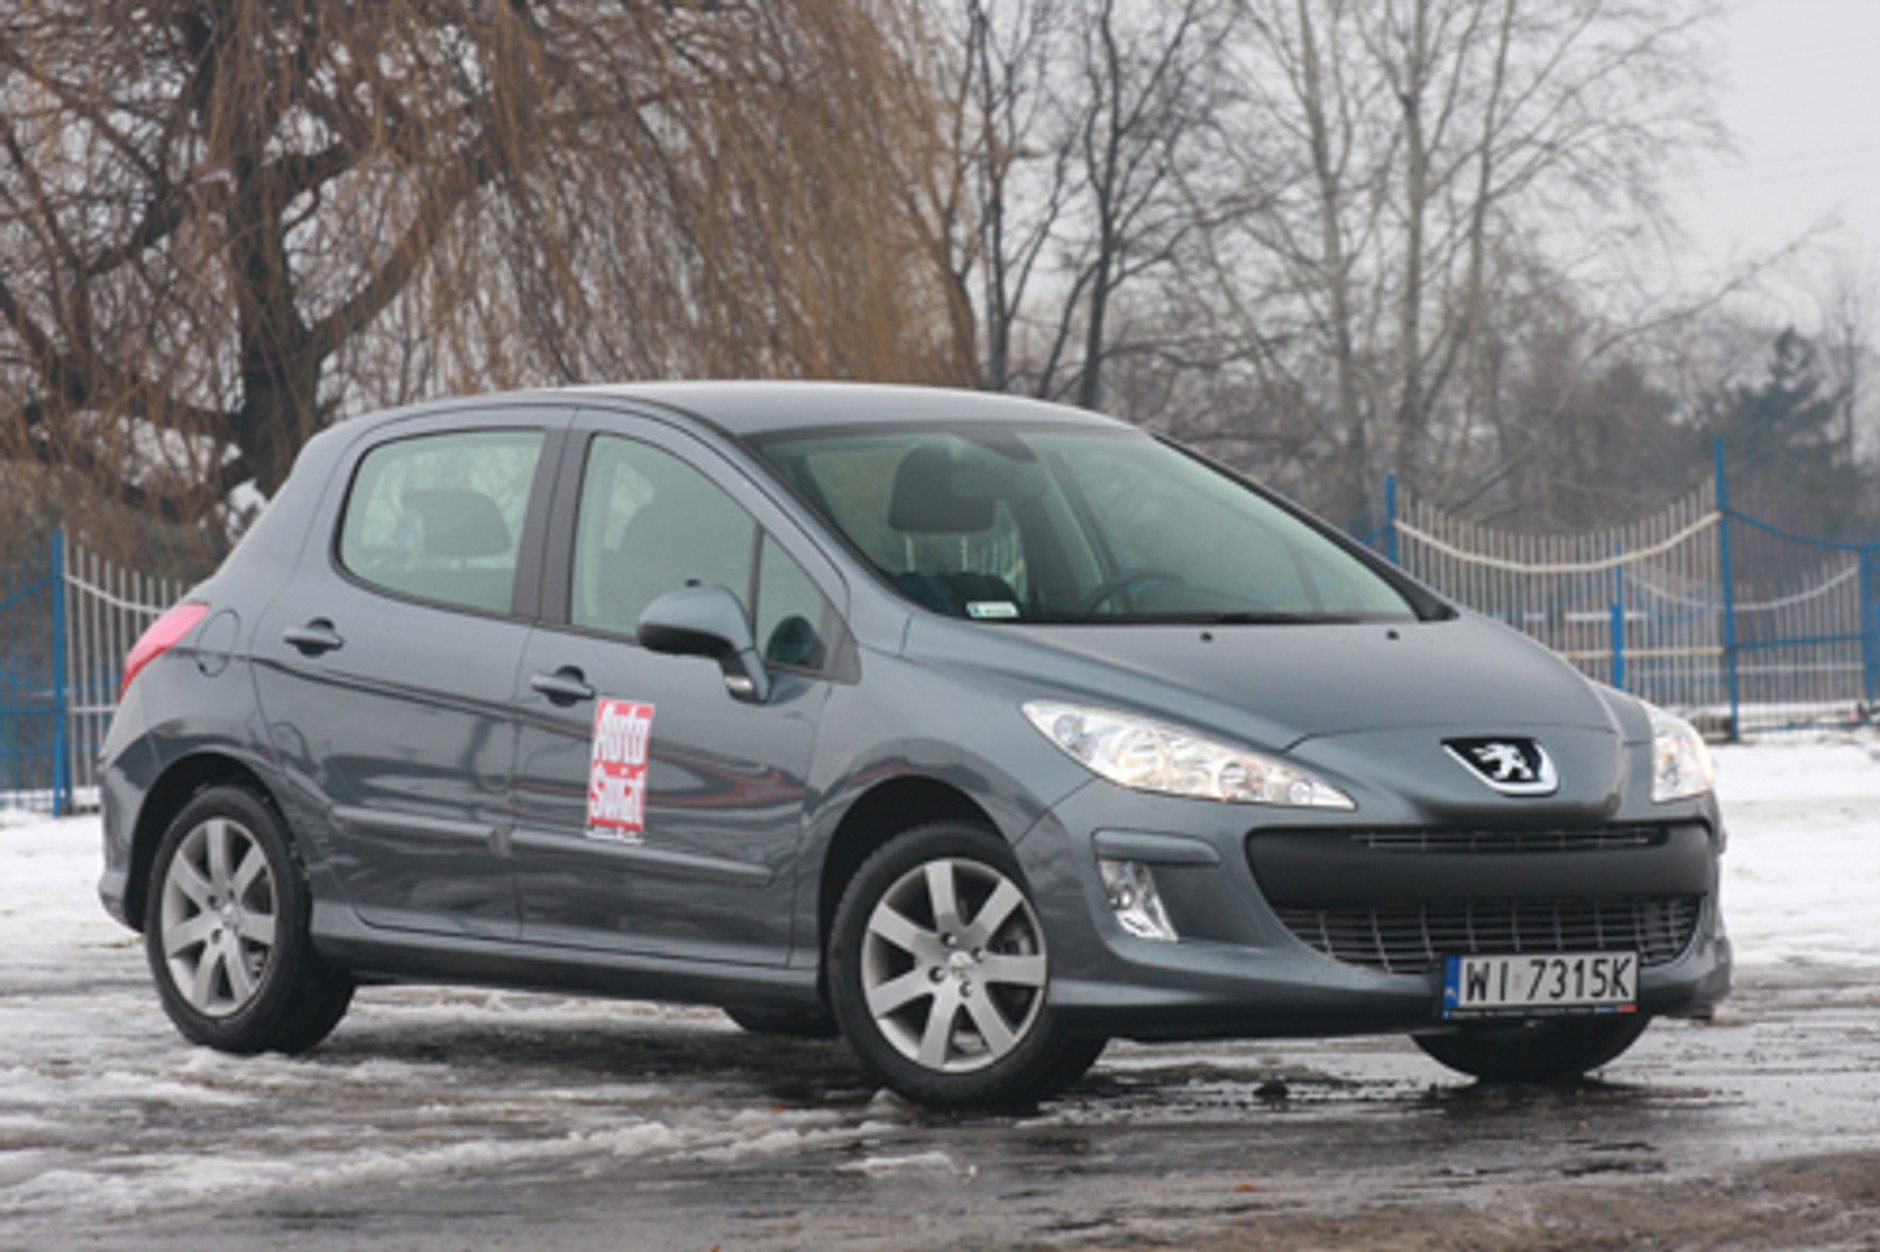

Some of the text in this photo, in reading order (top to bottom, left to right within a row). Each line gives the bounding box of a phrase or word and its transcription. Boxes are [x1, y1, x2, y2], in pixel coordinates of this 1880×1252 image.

[593, 702, 650, 765] Auto
[1465, 956, 1633, 1002] WI 7315K
